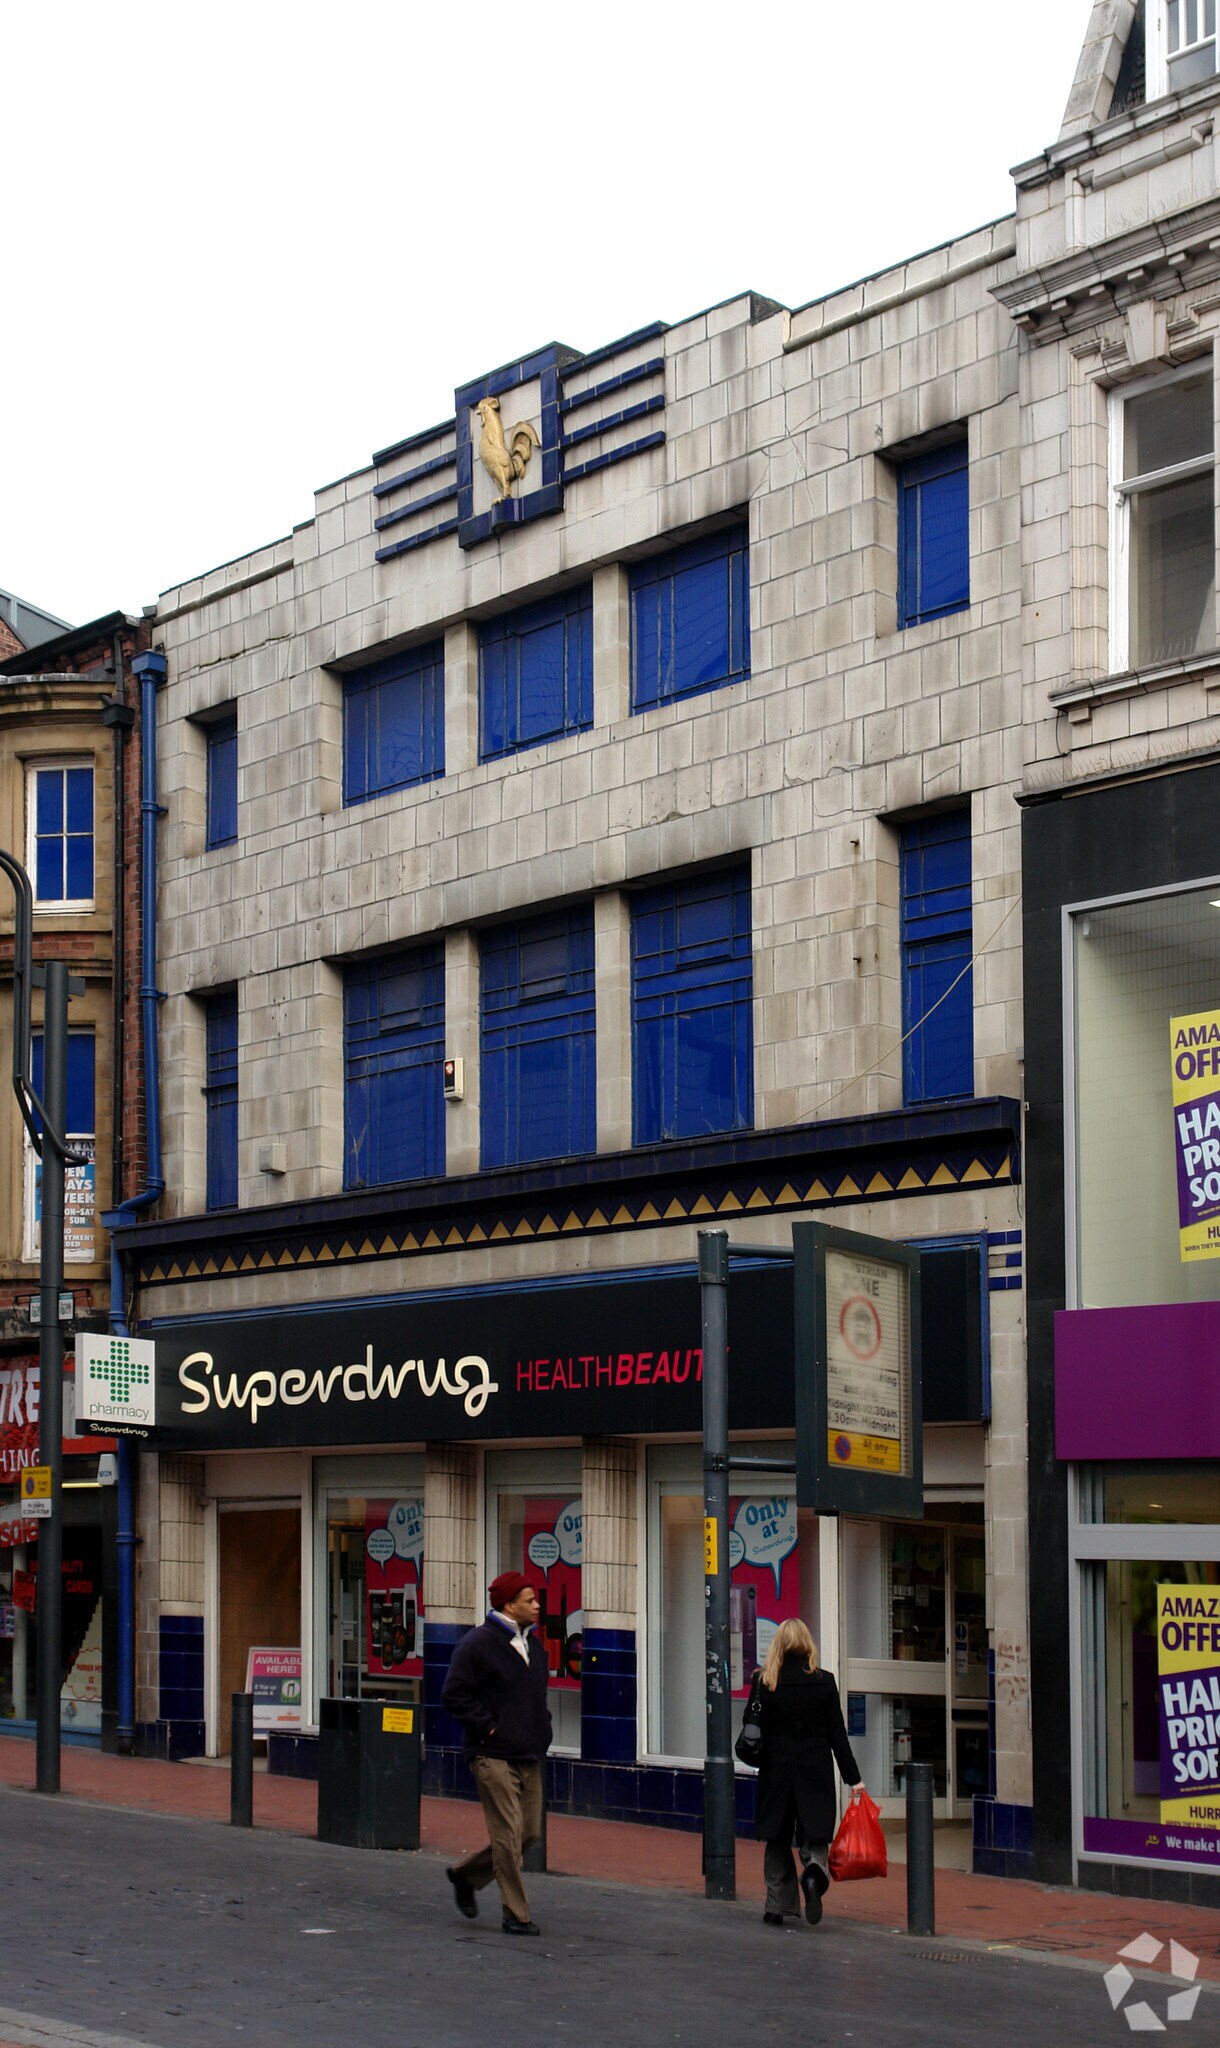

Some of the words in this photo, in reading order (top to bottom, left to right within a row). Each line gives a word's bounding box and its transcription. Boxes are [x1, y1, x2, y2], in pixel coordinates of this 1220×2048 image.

[64, 1167, 85, 1177] EN
[64, 1180, 93, 1190] AYS
[178, 1344, 499, 1424] Superdrug
[89, 1402, 150, 1421] pharmacy
[408, 1520, 421, 1536] at
[762, 1520, 779, 1539] at
[1165, 1836, 1182, 1849] We
[1184, 1838, 1215, 1852] make
